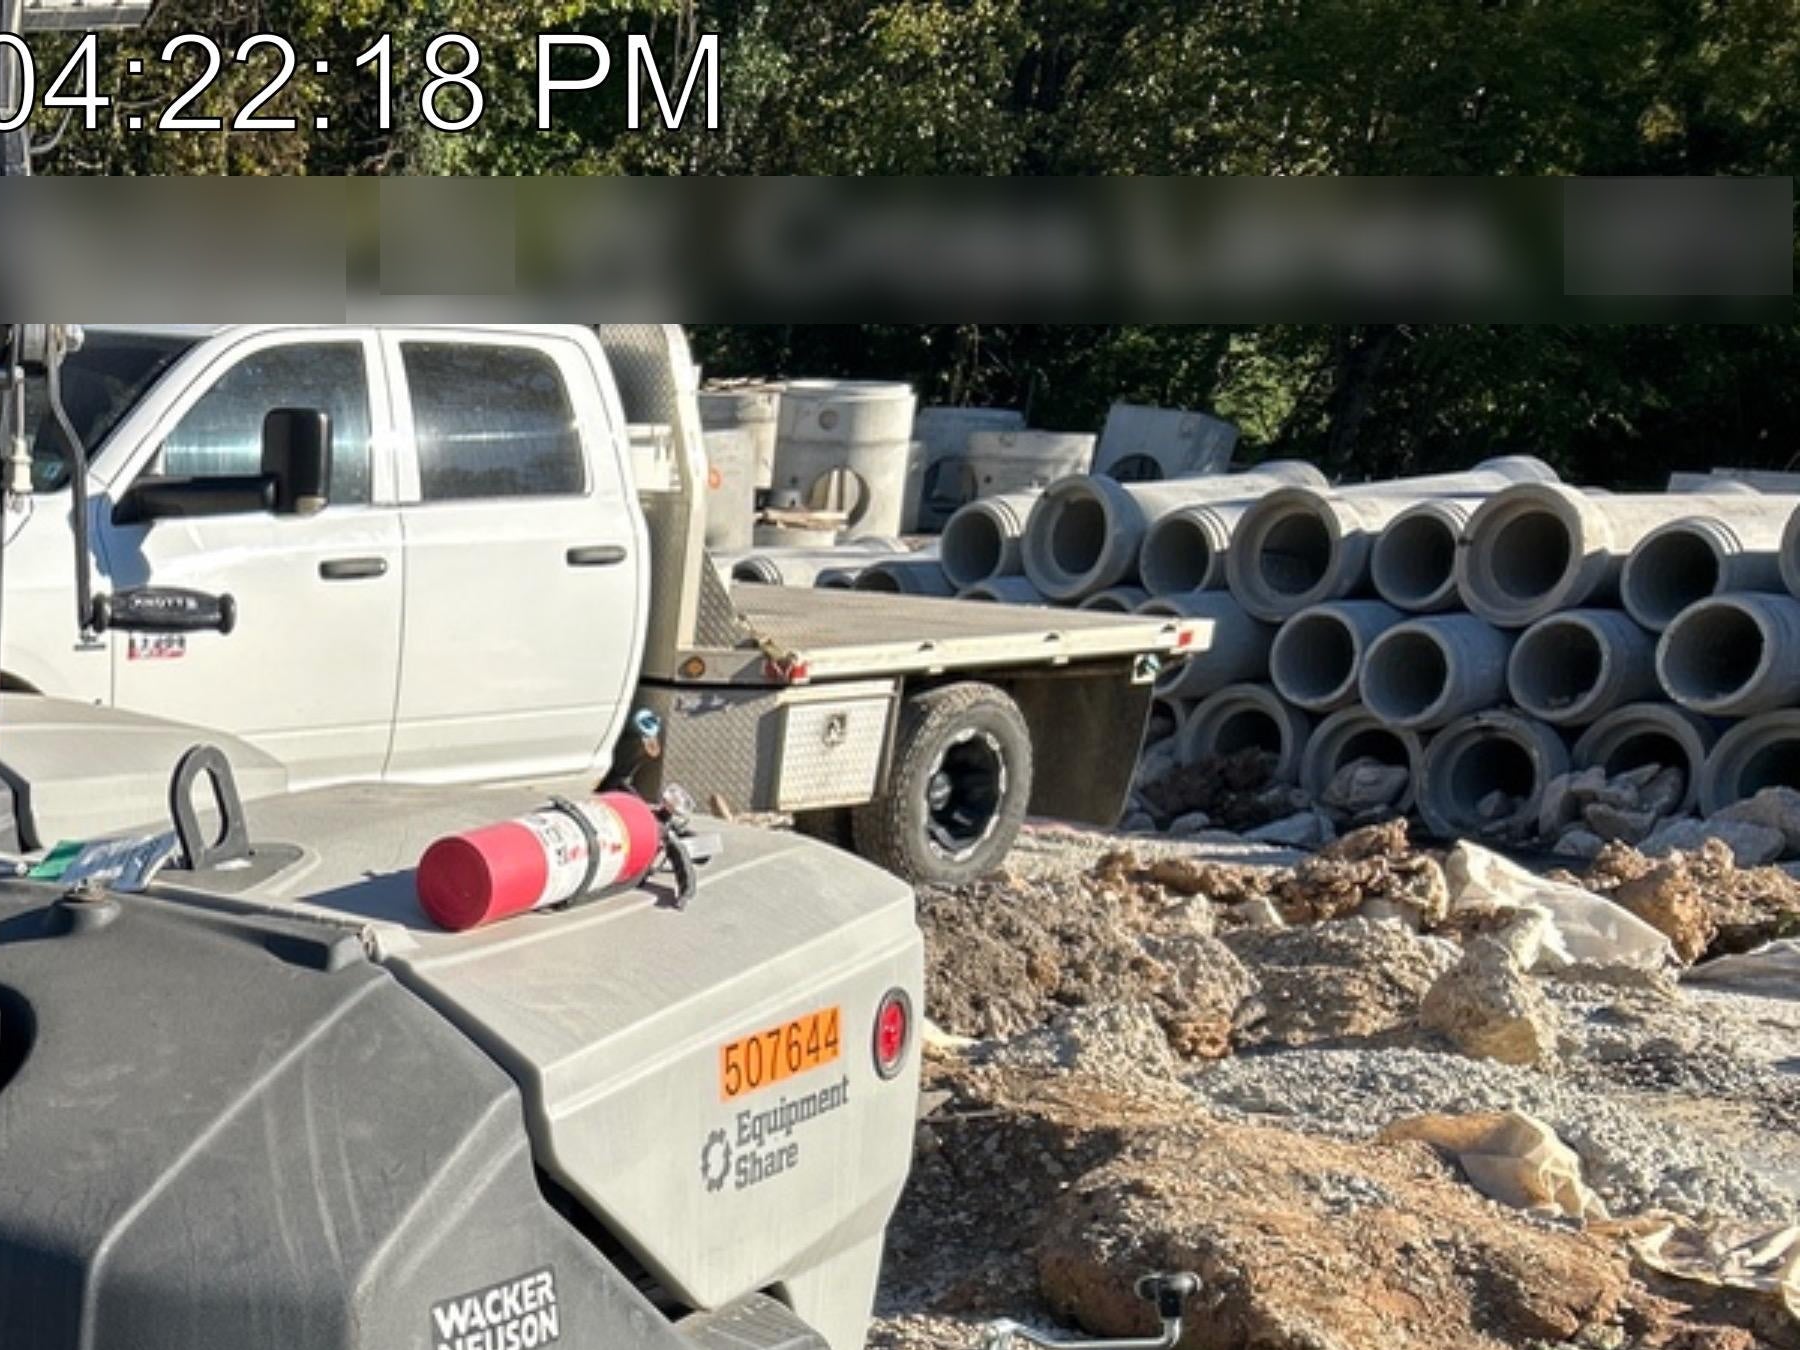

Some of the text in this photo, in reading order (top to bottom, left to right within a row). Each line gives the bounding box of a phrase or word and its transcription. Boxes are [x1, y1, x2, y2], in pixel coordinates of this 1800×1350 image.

[725, 1008, 839, 1095] 507644
[736, 1073, 850, 1147] Equipment
[734, 1141, 800, 1191] Share
[432, 1270, 556, 1339] WACKER
